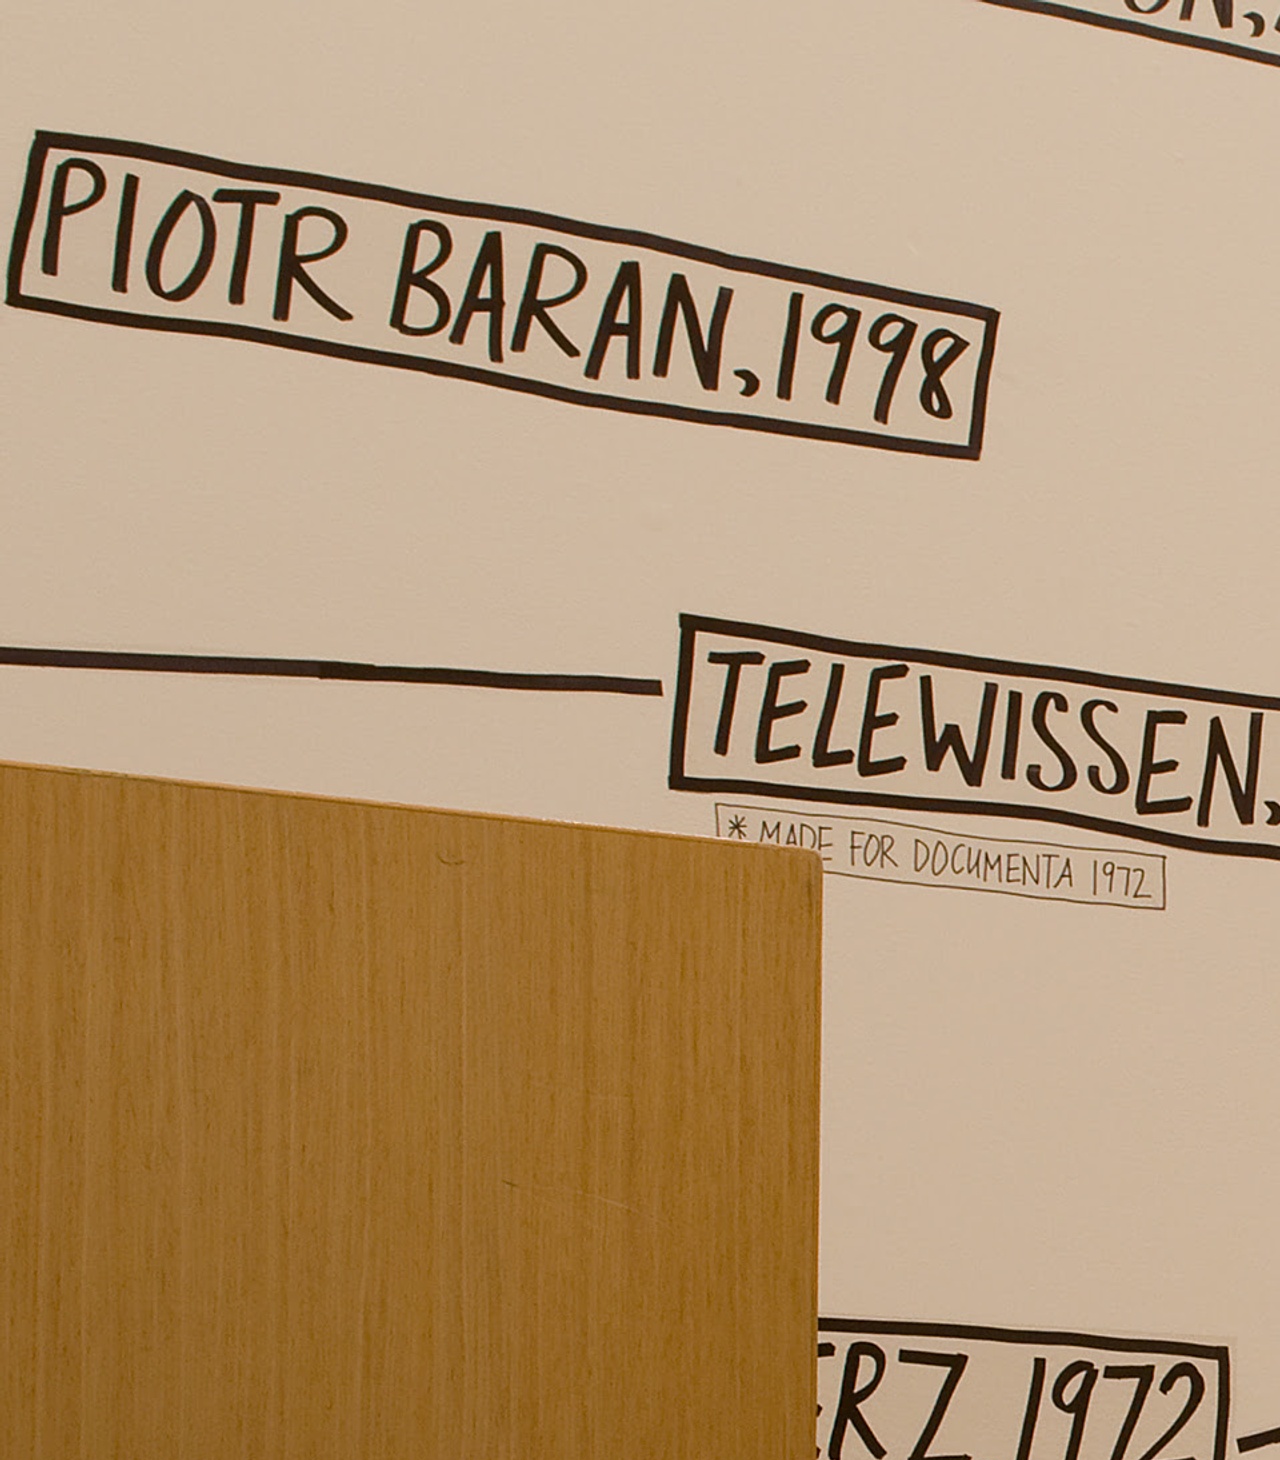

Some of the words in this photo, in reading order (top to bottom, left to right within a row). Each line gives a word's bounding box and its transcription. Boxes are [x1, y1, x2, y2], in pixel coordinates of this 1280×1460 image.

[40, 157, 353, 323] PIOTR
[850, 831, 899, 870] FOR
[913, 838, 1074, 890] DOCUMENTA
[1092, 859, 1152, 899] 1972
